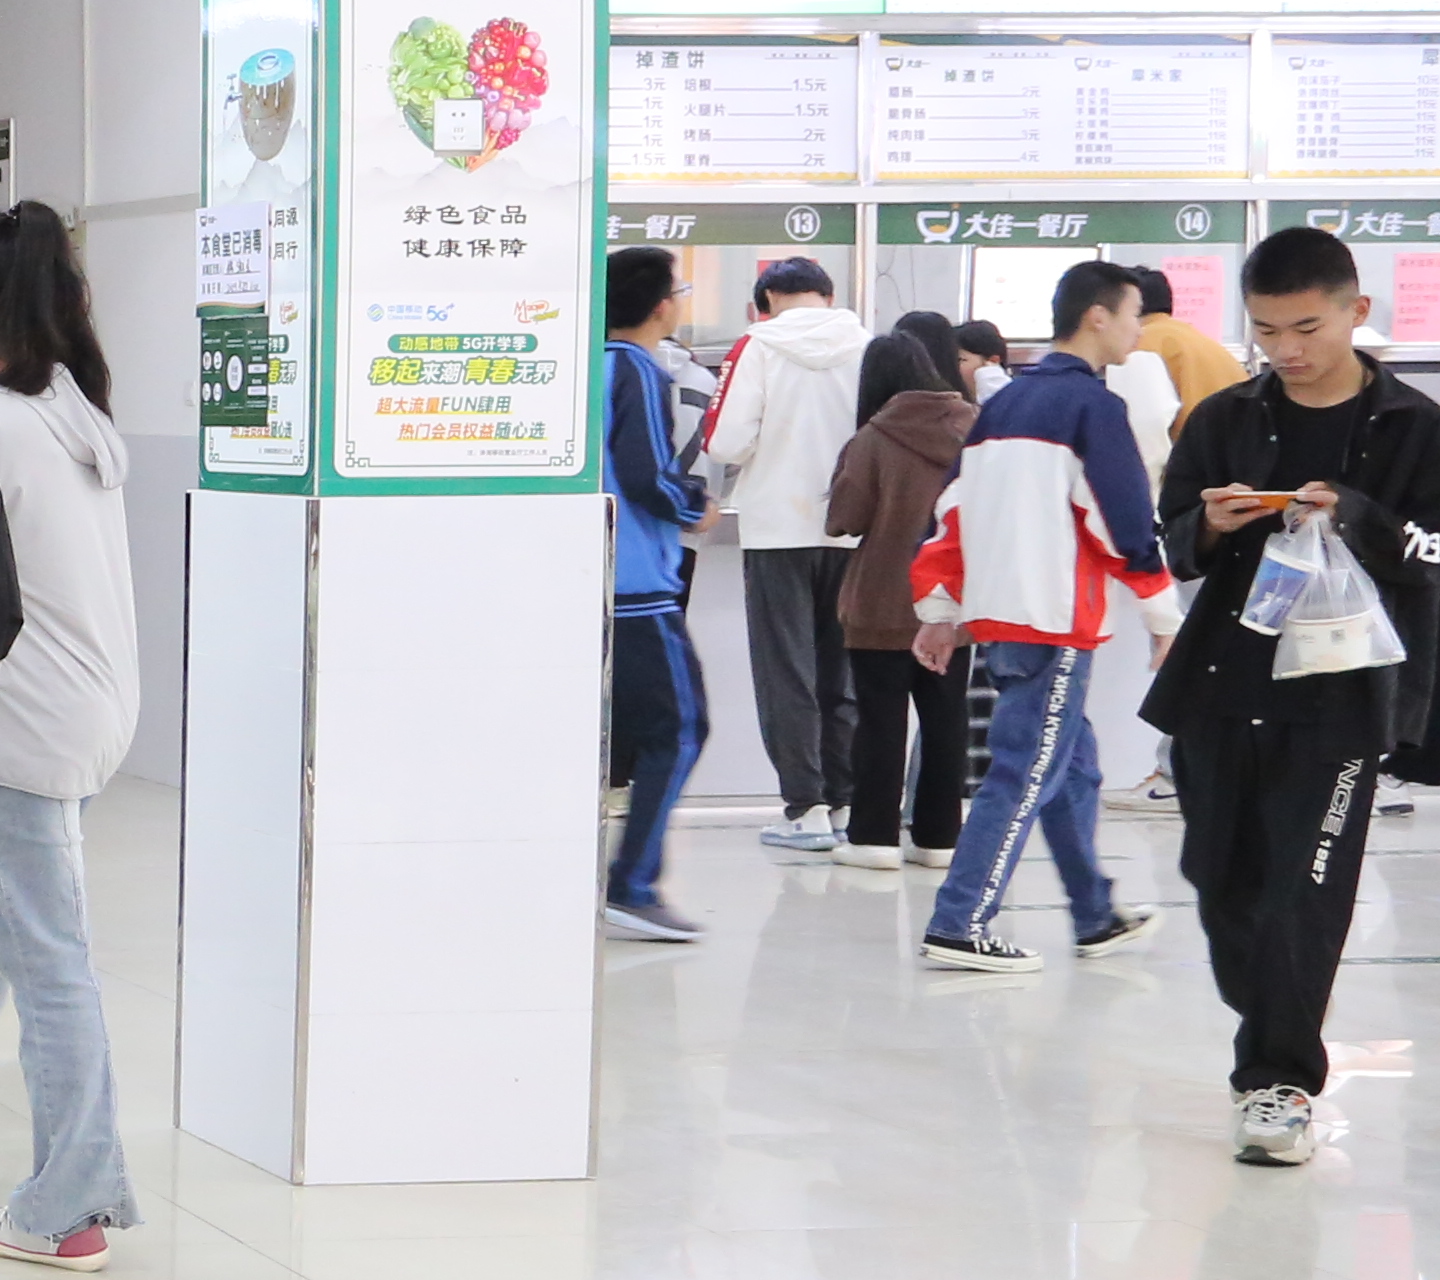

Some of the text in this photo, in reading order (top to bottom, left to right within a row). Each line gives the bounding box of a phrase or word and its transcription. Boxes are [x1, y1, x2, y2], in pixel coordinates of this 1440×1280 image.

[637, 50, 704, 69] 掉渣饼
[644, 77, 666, 91] 3元
[793, 78, 827, 92] 1.5元
[684, 104, 829, 117] 火腿片 1.5元
[684, 128, 826, 142] 烤肠 2元
[803, 154, 825, 167] 2元
[403, 205, 527, 225] 绿色食品
[791, 214, 813, 233] 13
[962, 212, 1203, 239] 大佳一餐厅 14
[201, 229, 261, 258] 本食堂已消毒
[402, 238, 528, 258] 健康保障
[398, 335, 528, 351] 动感地带 5G开学季
[370, 356, 556, 385] 移起来潮 青春无界
[376, 395, 511, 414] 超大流量FUN肆用
[397, 421, 546, 440] 热门会员权益随心选
